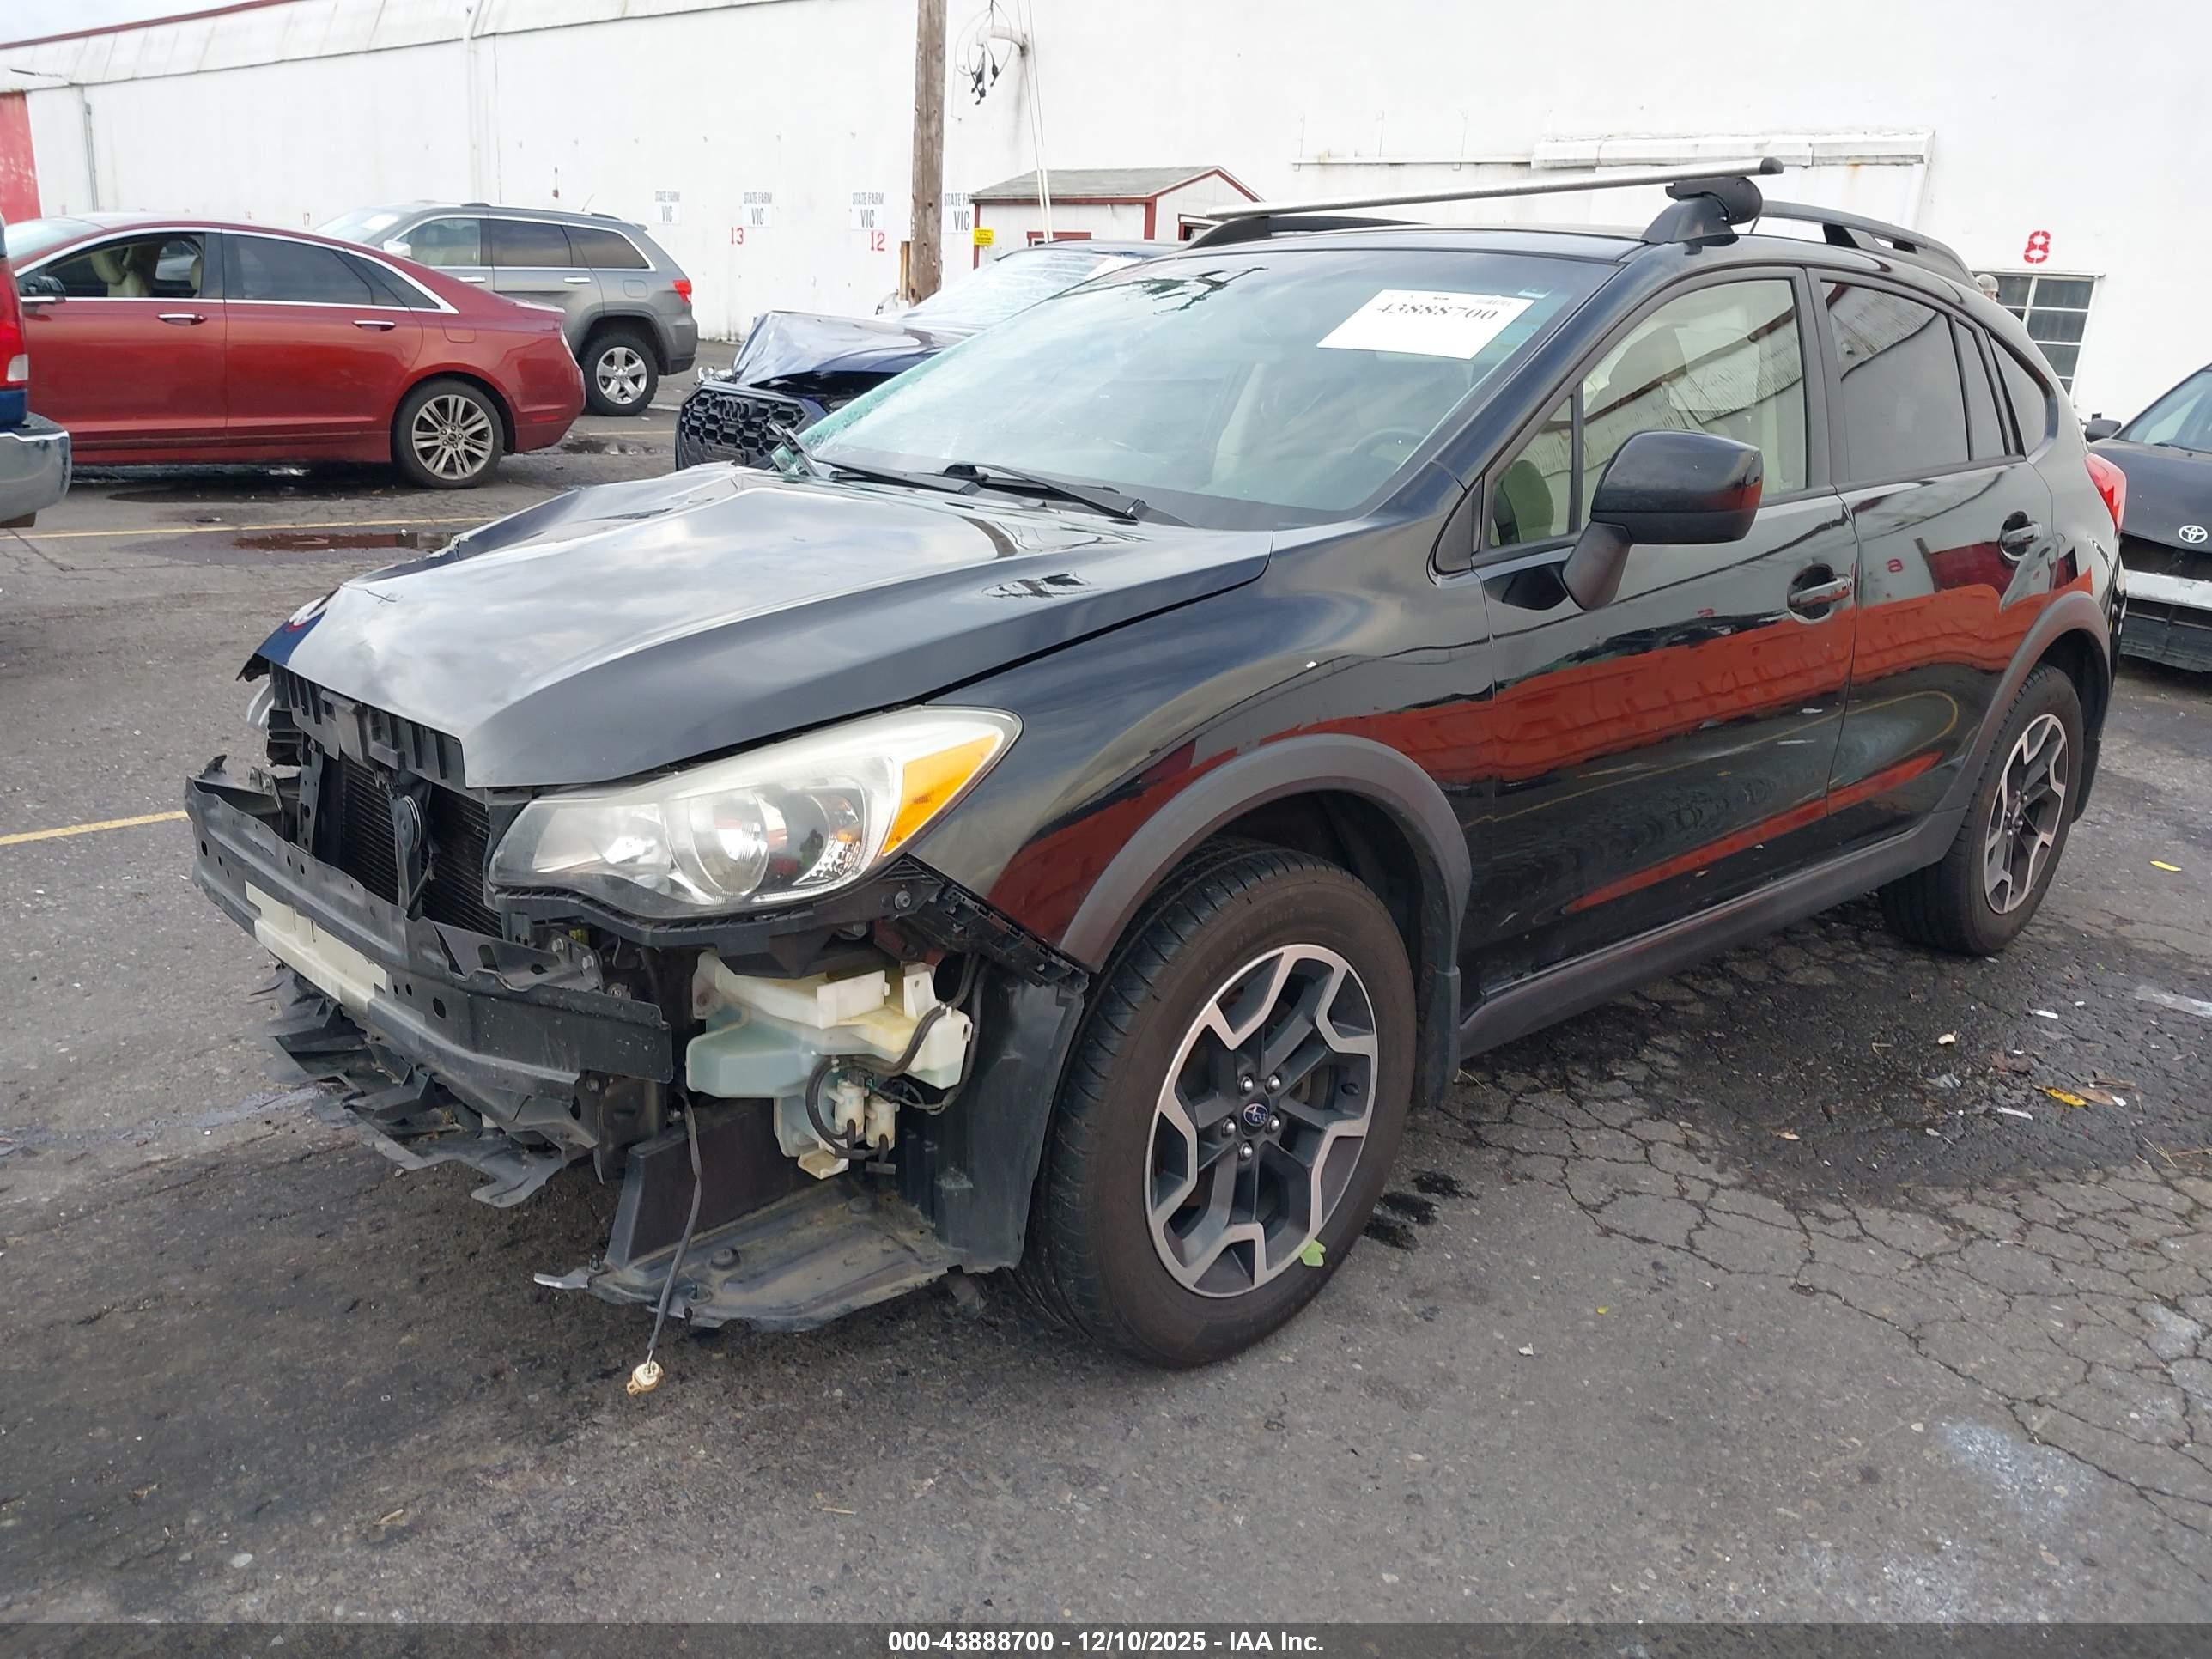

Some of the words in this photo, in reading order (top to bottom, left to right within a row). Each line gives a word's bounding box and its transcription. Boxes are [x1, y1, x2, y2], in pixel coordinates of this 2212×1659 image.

[744, 191, 757, 204] STATE
[758, 191, 773, 204] FARM
[853, 192, 866, 205] STATE
[867, 192, 884, 205] FARM
[944, 192, 961, 207] STATE
[751, 207, 764, 225] VIC
[860, 209, 875, 228] VIC
[953, 210, 969, 231] VIC
[731, 227, 744, 245] 13
[871, 232, 885, 251] 12
[2023, 230, 2051, 264] 8
